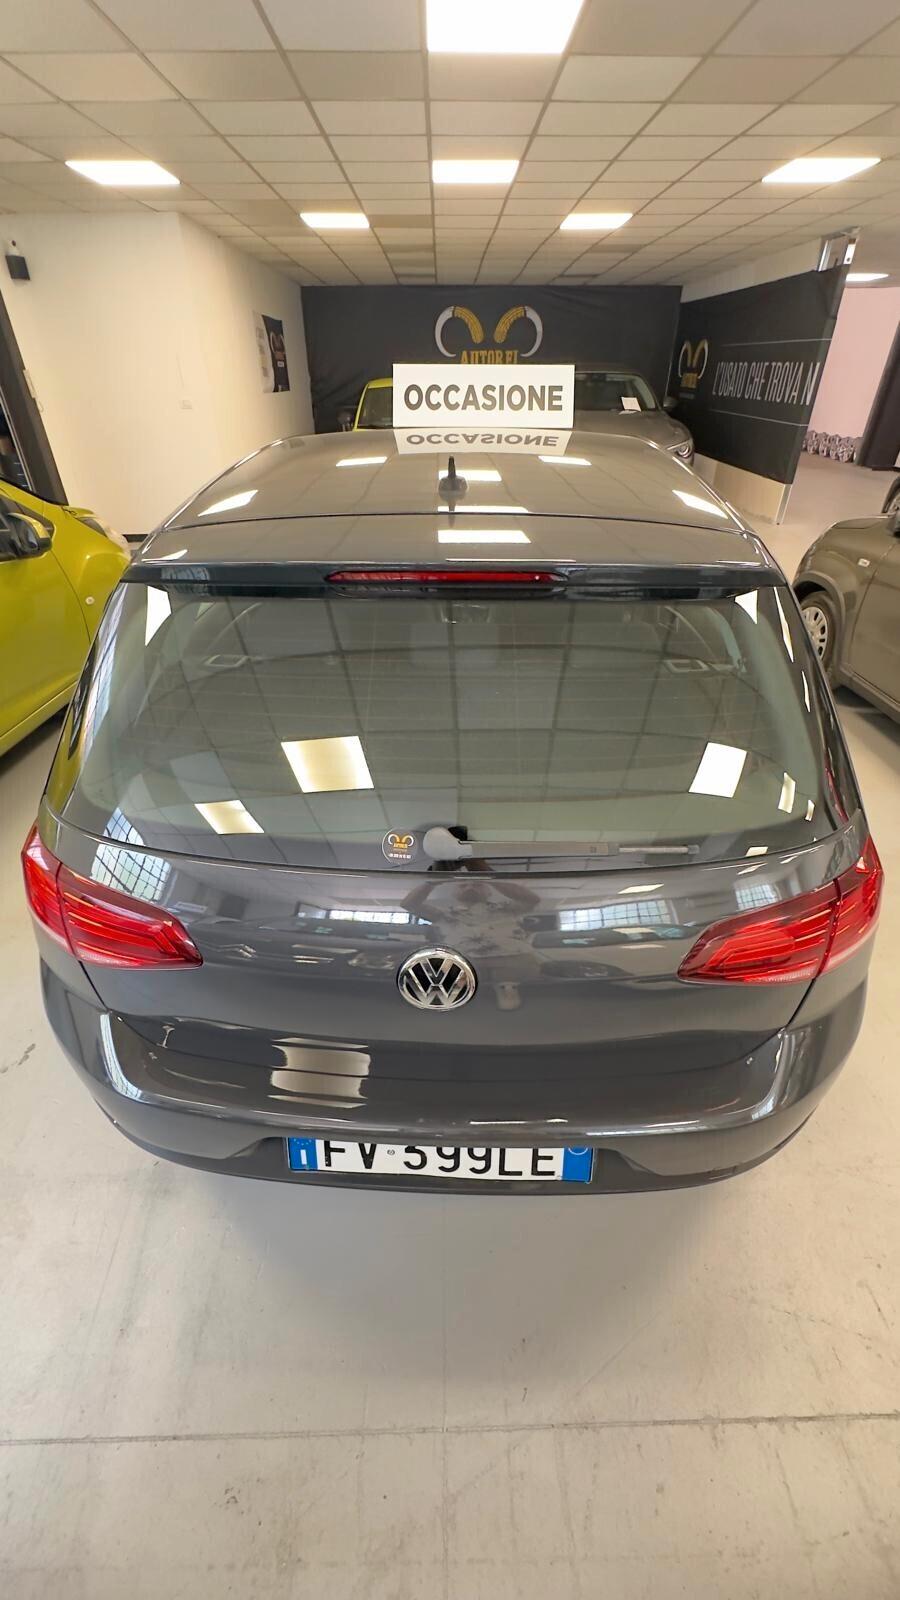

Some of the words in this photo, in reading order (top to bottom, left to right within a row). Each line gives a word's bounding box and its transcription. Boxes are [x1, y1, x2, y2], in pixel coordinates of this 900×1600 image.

[403, 383, 563, 411] OCCASIONE
[712, 361, 748, 397] L'USATO
[744, 362, 769, 401] CHE
[764, 362, 804, 405] TROVA
